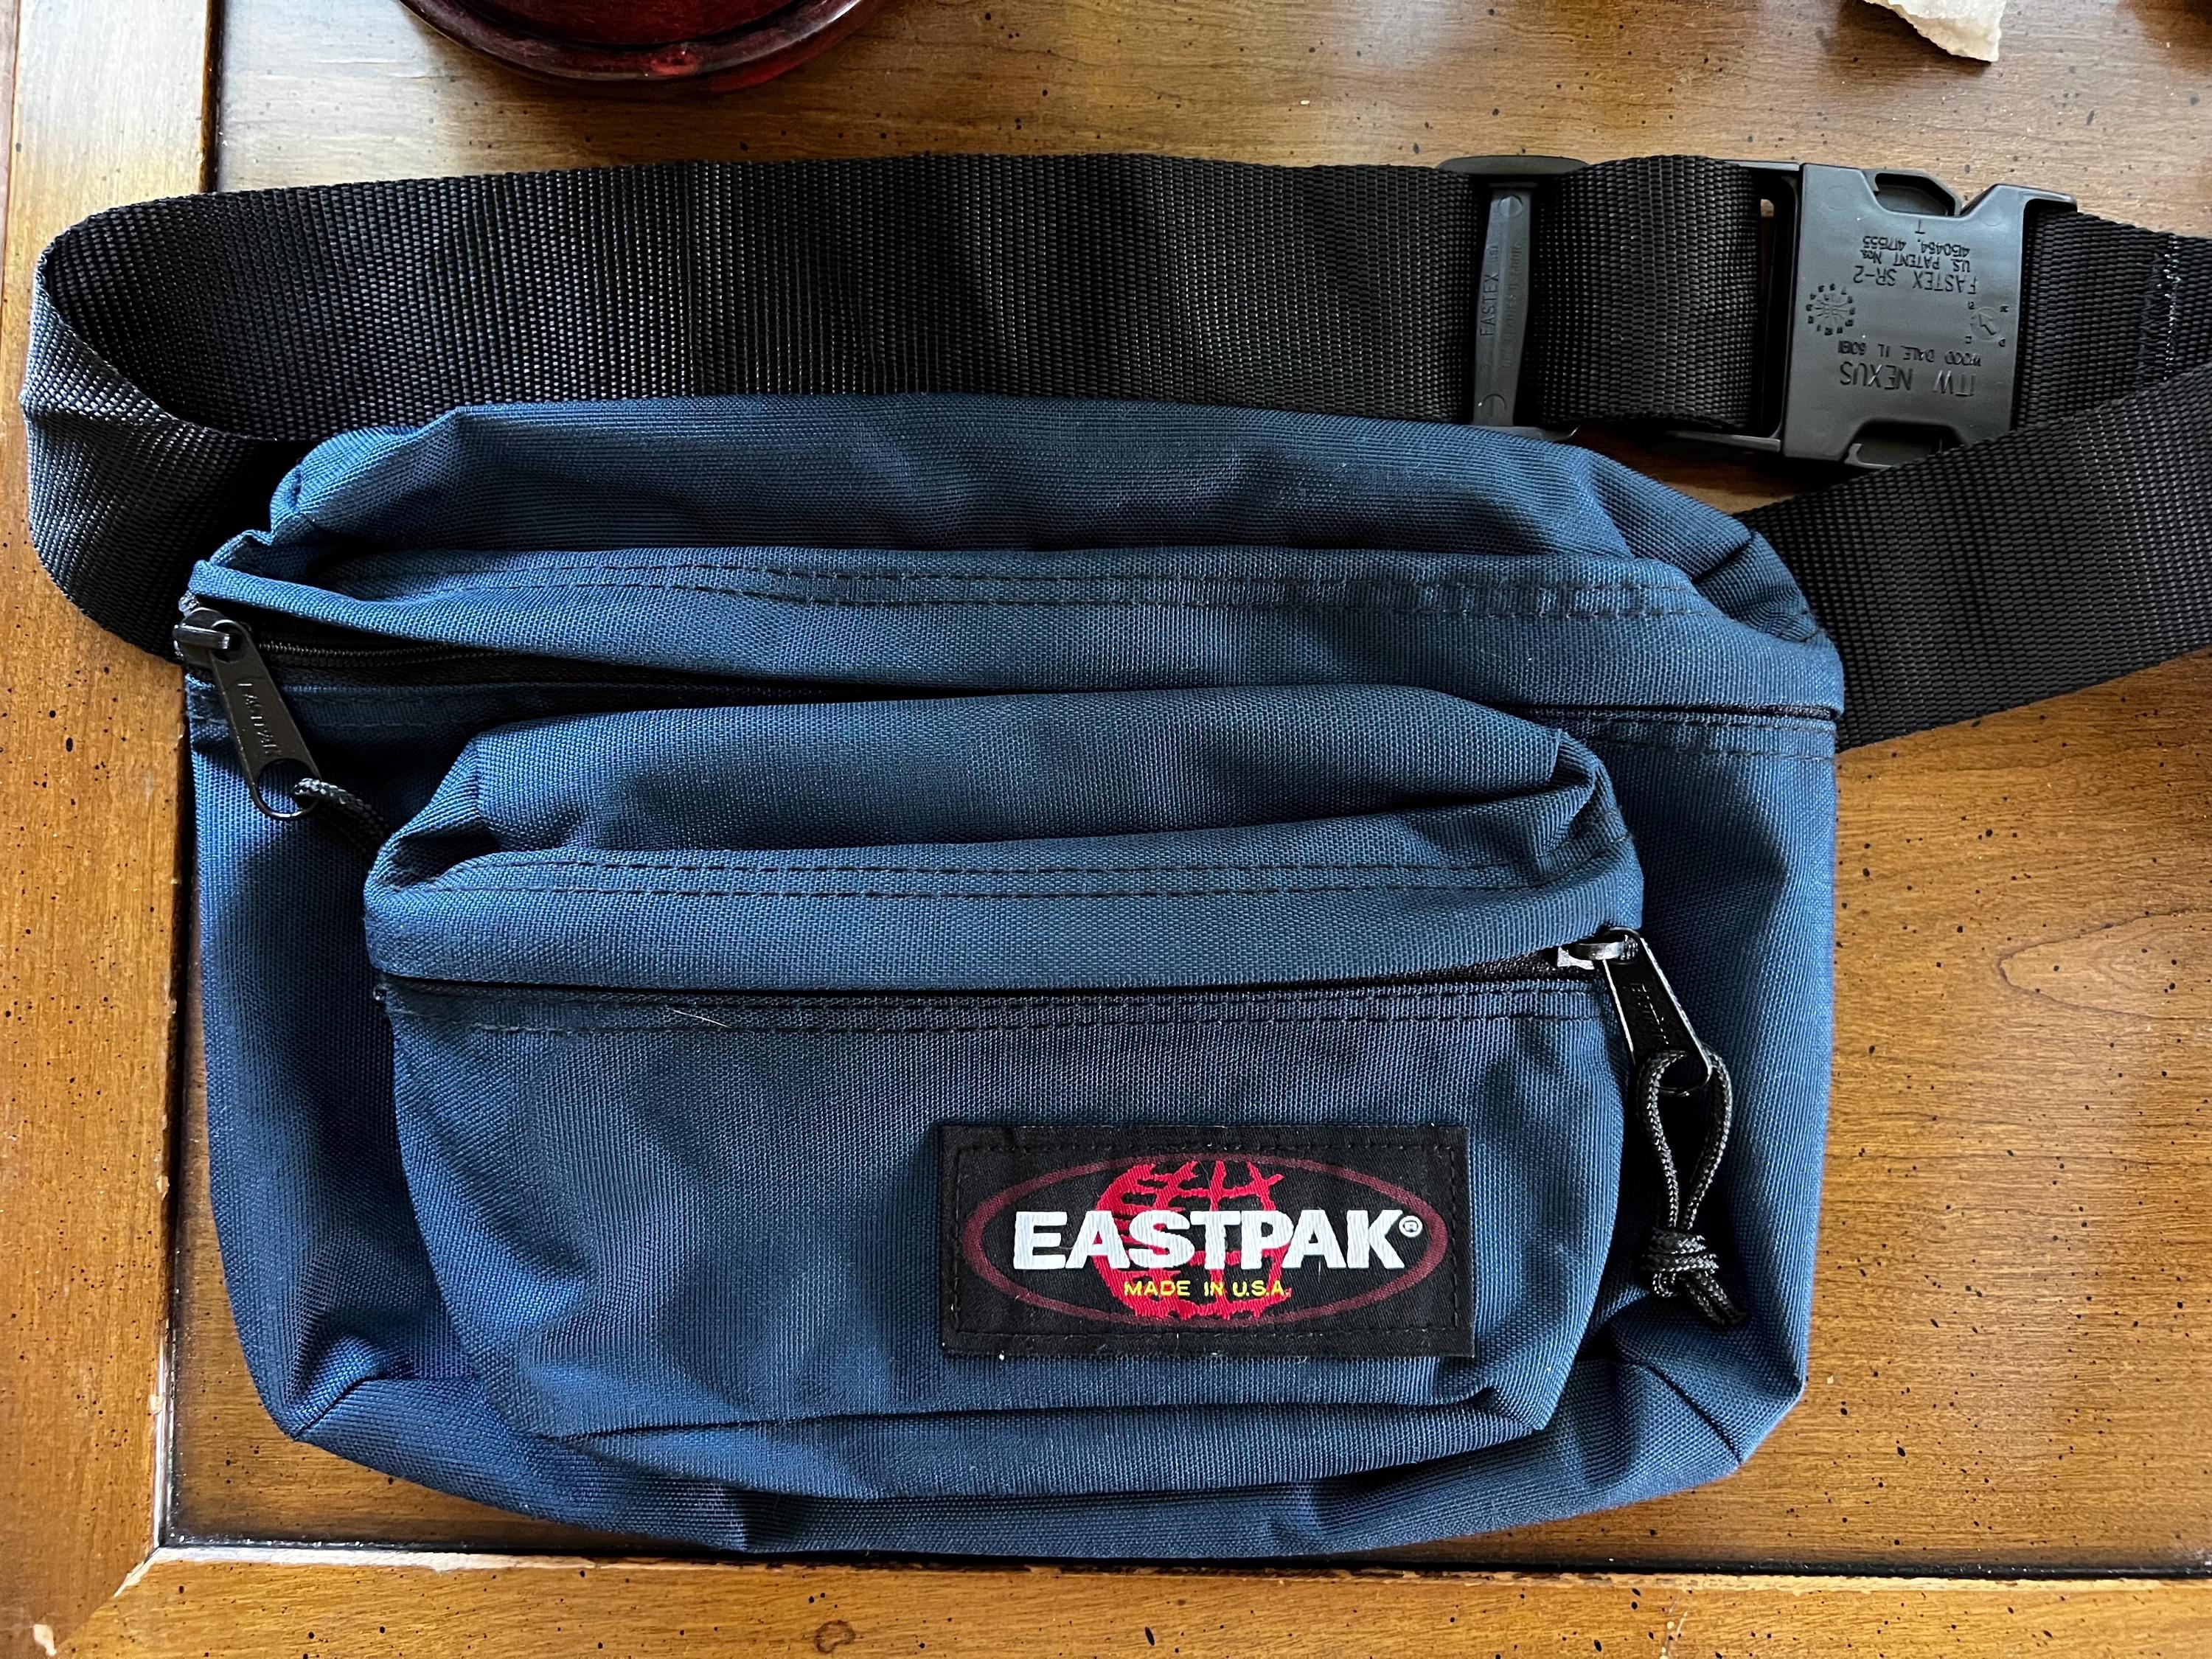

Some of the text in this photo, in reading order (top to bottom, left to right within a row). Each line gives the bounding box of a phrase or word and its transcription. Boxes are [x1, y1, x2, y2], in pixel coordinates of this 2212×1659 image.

[1893, 252, 1940, 270] PATENT
[1853, 265, 1977, 294] FASTEX SR-2
[1479, 274, 1500, 337] FASTEX
[1878, 344, 1891, 358] IL
[1944, 350, 1982, 367] WOOD
[1840, 361, 1978, 397] ITW NEXUS
[1124, 1280, 1290, 1298] MADE IN U.S.A.
